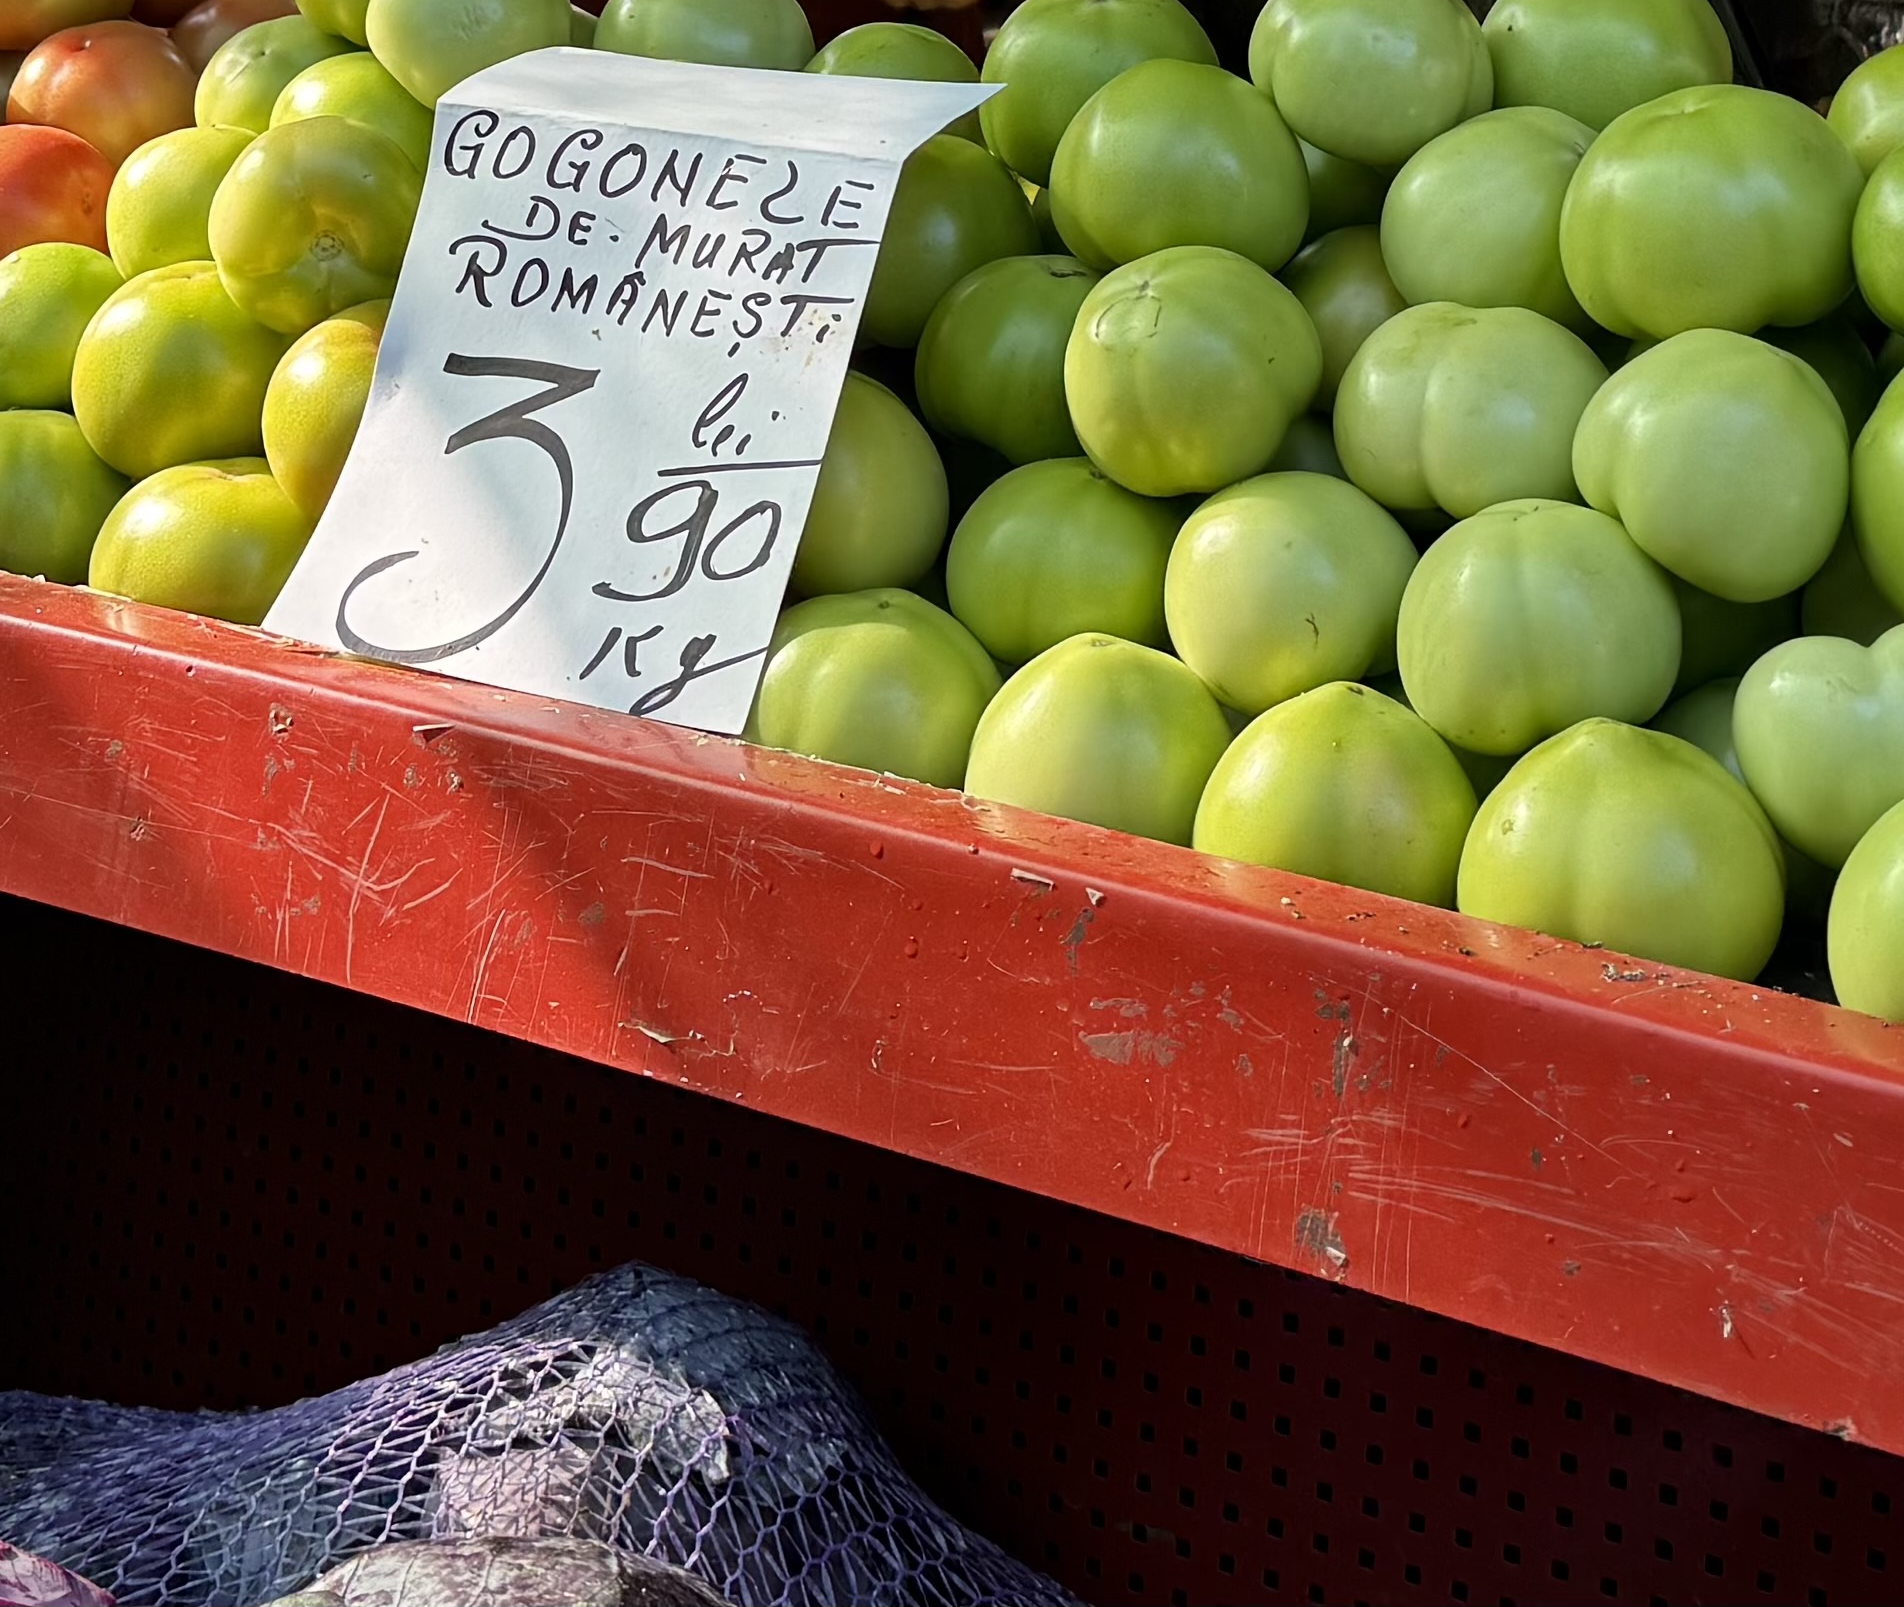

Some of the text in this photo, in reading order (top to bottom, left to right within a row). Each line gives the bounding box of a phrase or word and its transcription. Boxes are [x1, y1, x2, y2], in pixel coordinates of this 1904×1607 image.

[635, 212, 882, 284] MURAT
[336, 352, 602, 663] 3
[591, 480, 782, 601] 90
